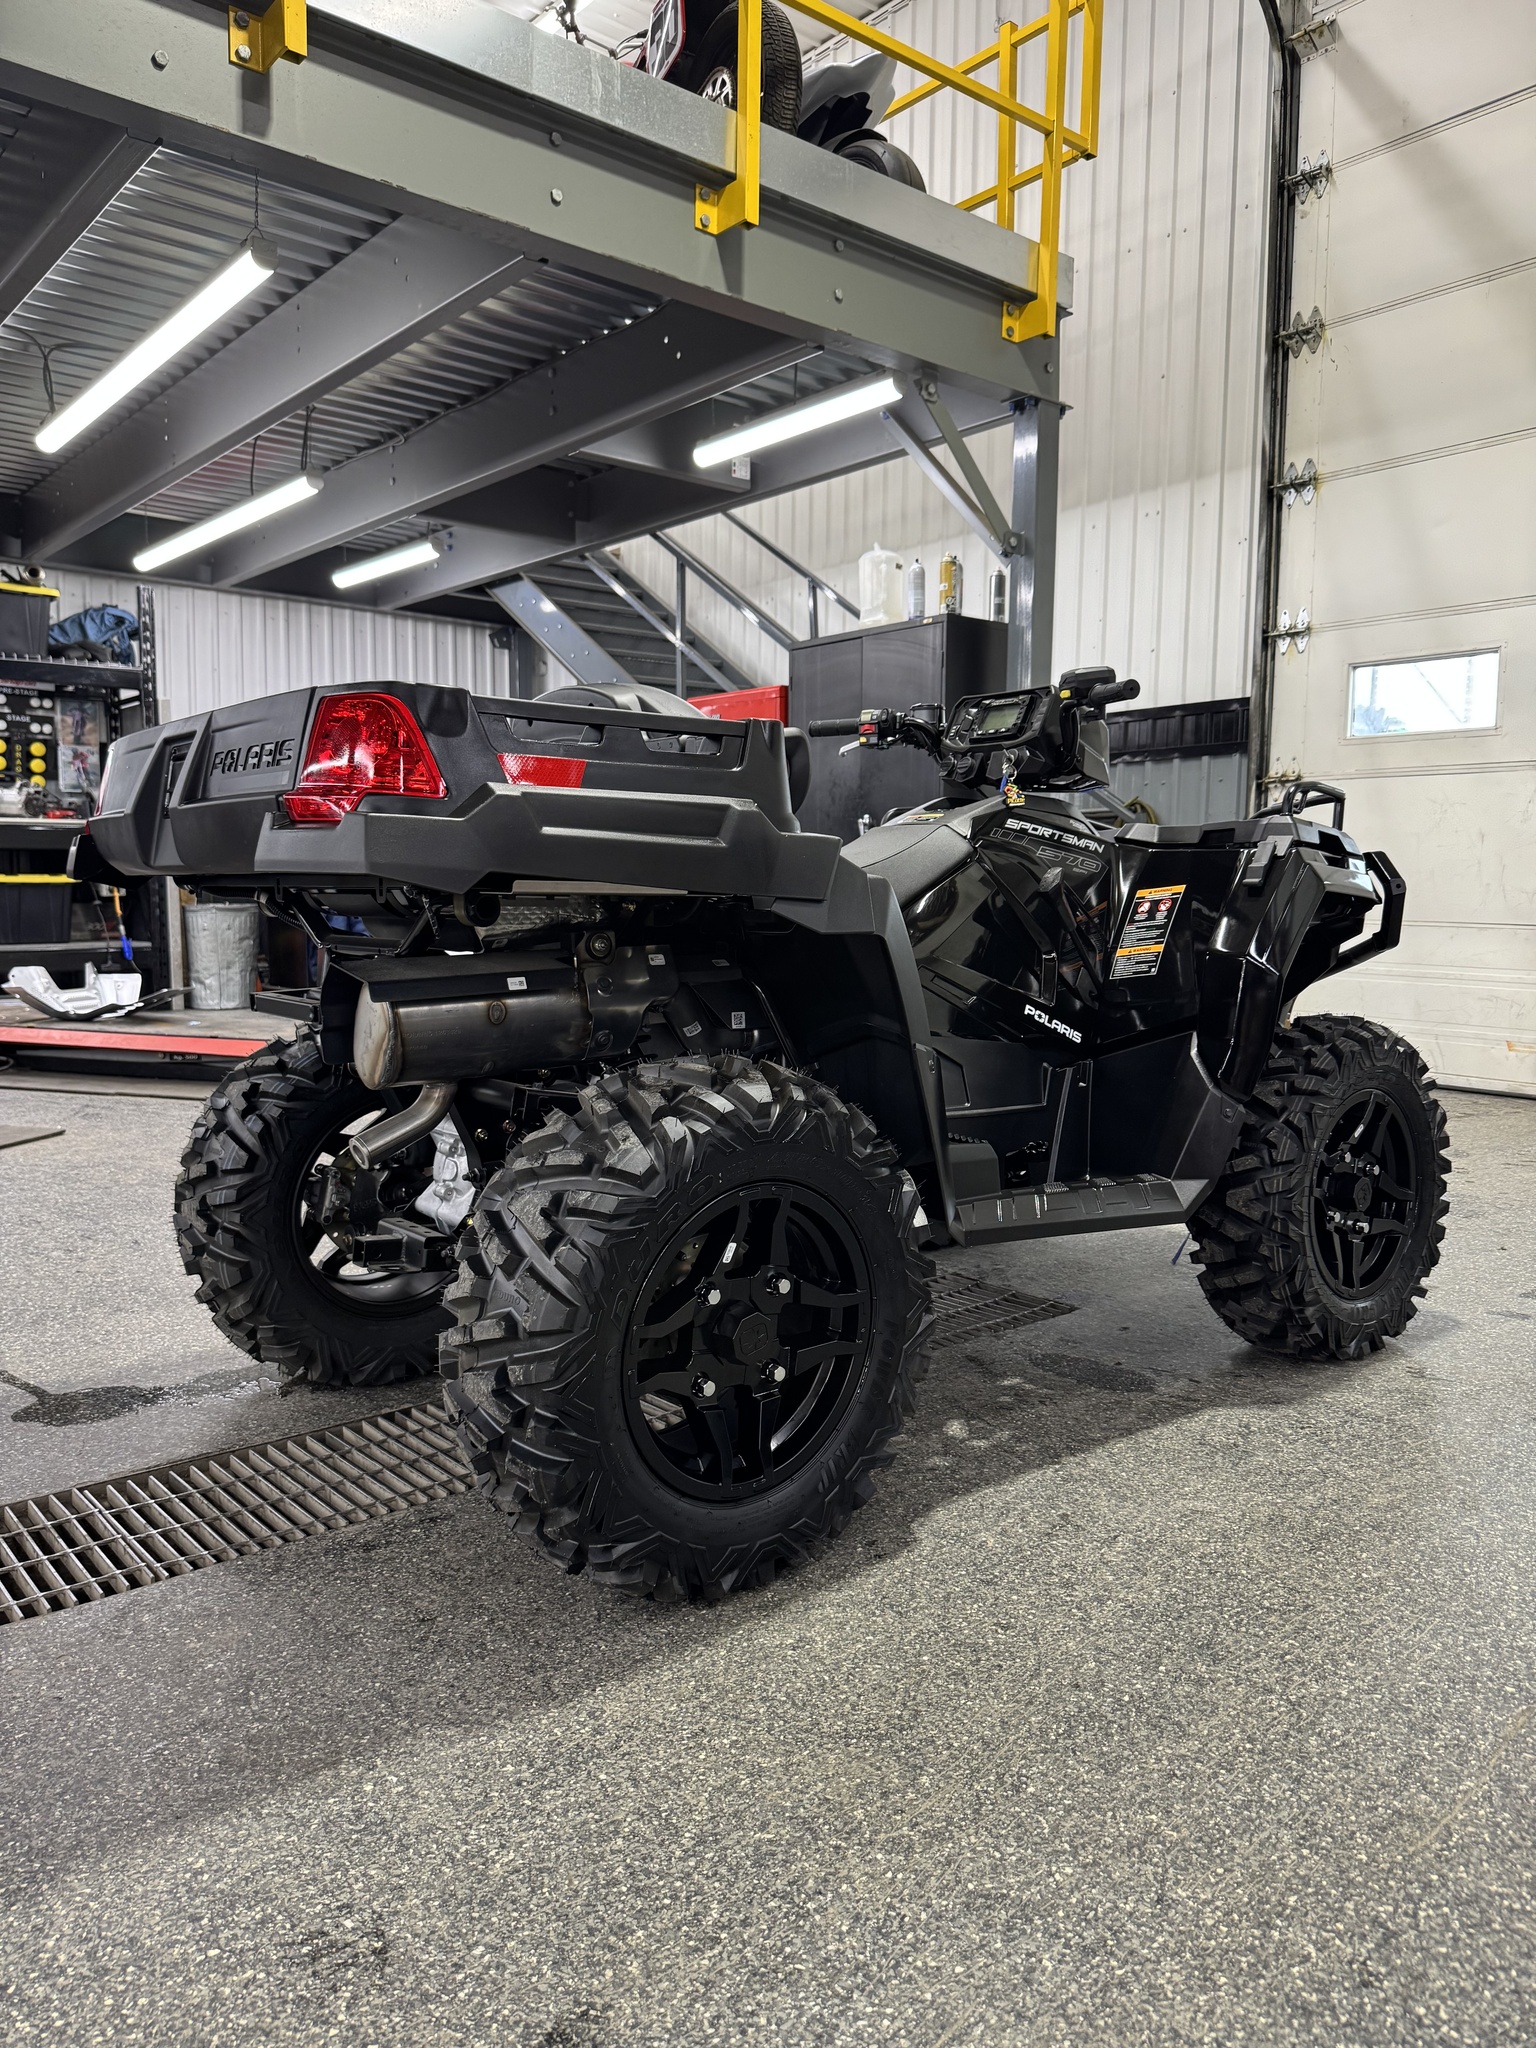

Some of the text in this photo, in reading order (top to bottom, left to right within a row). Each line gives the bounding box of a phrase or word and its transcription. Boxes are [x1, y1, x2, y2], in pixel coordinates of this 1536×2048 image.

[6, 714, 31, 722] STAGE
[210, 739, 295, 777] POLARIS
[1005, 818, 1105, 853] SPORTSMAN
[1036, 845, 1102, 872] 570
[1024, 1004, 1082, 1043] POLARIS
